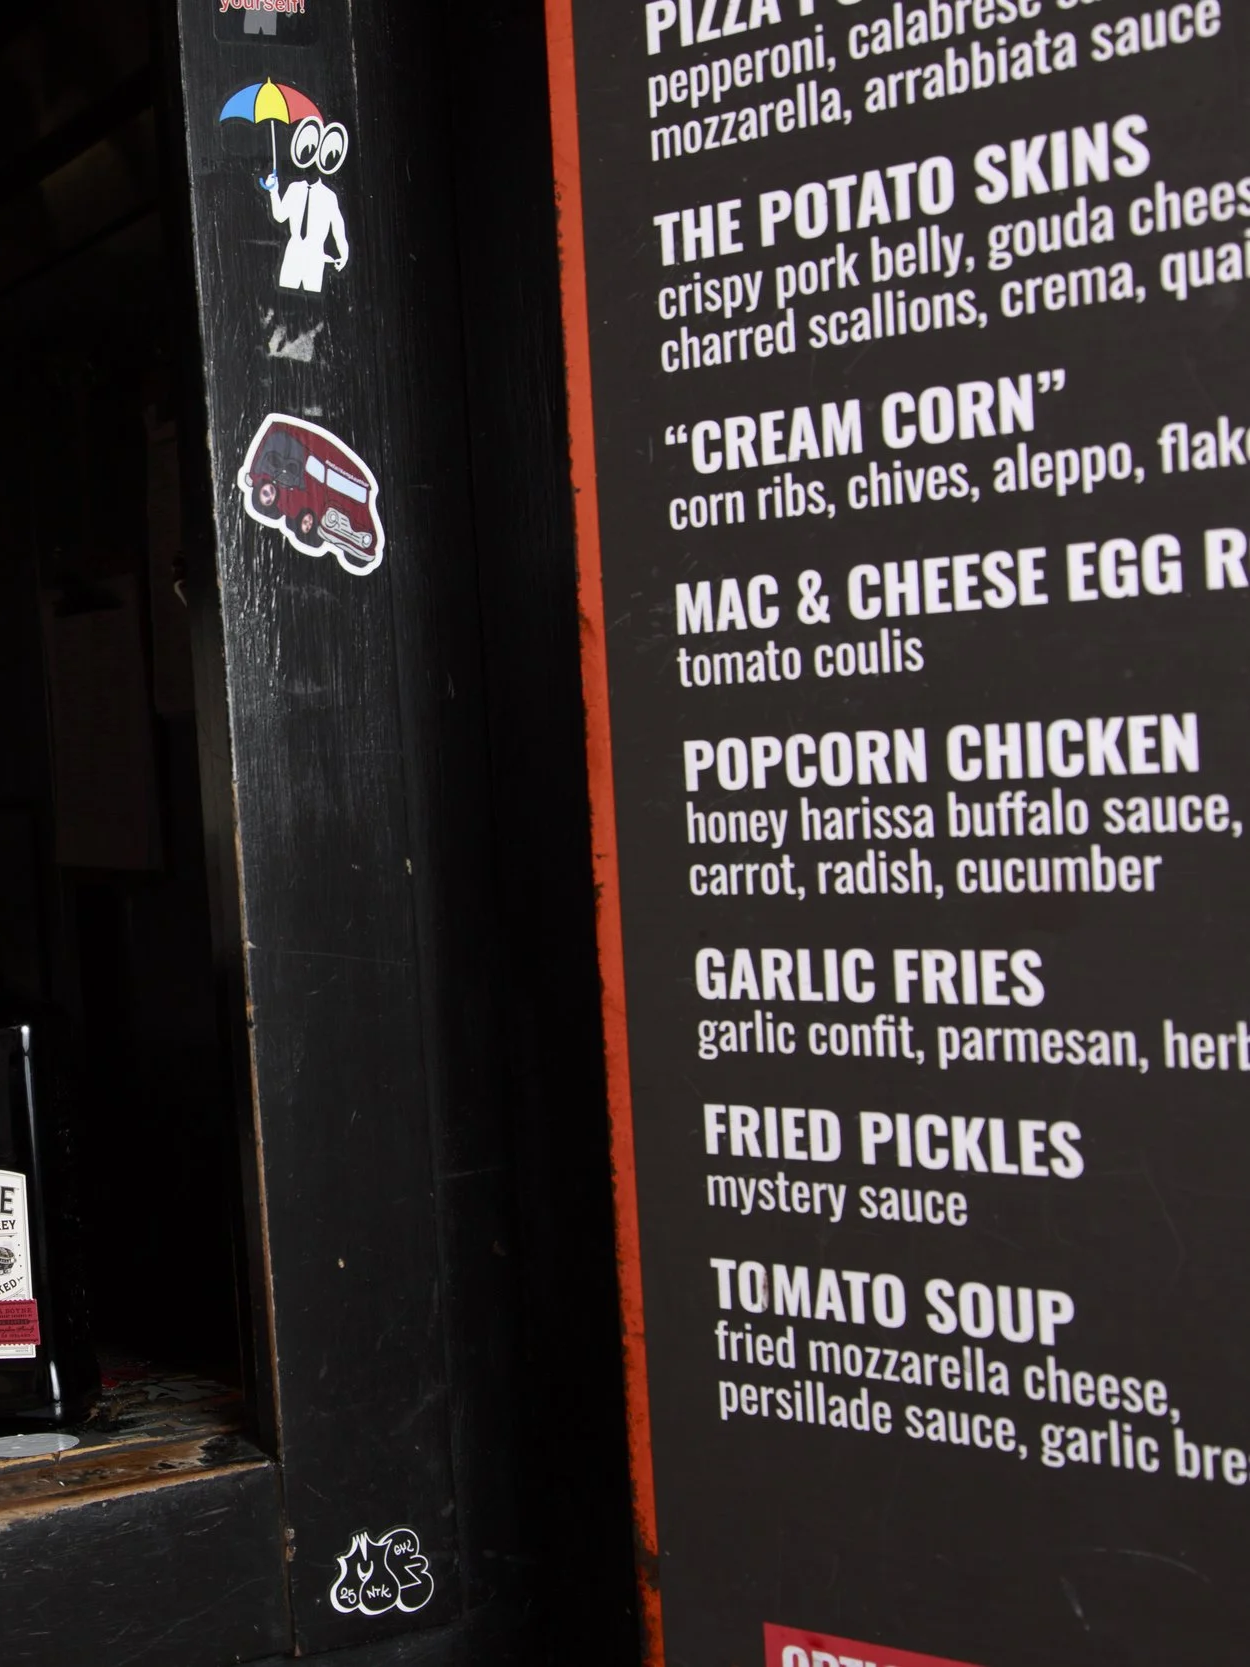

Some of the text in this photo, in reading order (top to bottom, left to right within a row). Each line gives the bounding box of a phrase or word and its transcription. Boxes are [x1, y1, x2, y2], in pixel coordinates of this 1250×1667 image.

[648, 23, 836, 119] pepperoni,
[650, 0, 1221, 162] mozzarella, arrabbiata sauce
[653, 114, 1151, 267] THE POTATO SKINS
[658, 270, 764, 320] crispy
[775, 242, 860, 310] pork
[870, 224, 975, 283] belly,
[988, 196, 1115, 271] gouda
[660, 307, 796, 373] charred
[808, 288, 988, 349] scallions,
[1000, 262, 1146, 318] crema,
[669, 415, 1250, 531] corn ribs, chives, aleppo, flak
[675, 527, 1249, 636] MAC & CHEESE EGG R
[676, 627, 925, 688] tomato coulis
[683, 712, 1200, 792] POPCORN CHICKEN
[686, 787, 1243, 849] honey harissa buffalo sauce,
[689, 843, 1163, 901] carrot, radish, cucumber
[695, 947, 1045, 1007] GARLIC FRIES
[698, 1009, 796, 1060] garlic
[808, 1013, 925, 1065] confit,
[937, 1026, 1149, 1074] parmesan,
[703, 1103, 1084, 1179] FRIED PICKLES
[706, 1171, 968, 1226] mystery sauce
[709, 1257, 1075, 1346] TOMATO SOUP
[714, 1319, 1180, 1425] fried mozzarella cheese,
[718, 1380, 1248, 1485] persillade sauce, garlic bre
[339, 1587, 357, 1604] 25
[366, 1583, 392, 1599] NTK
